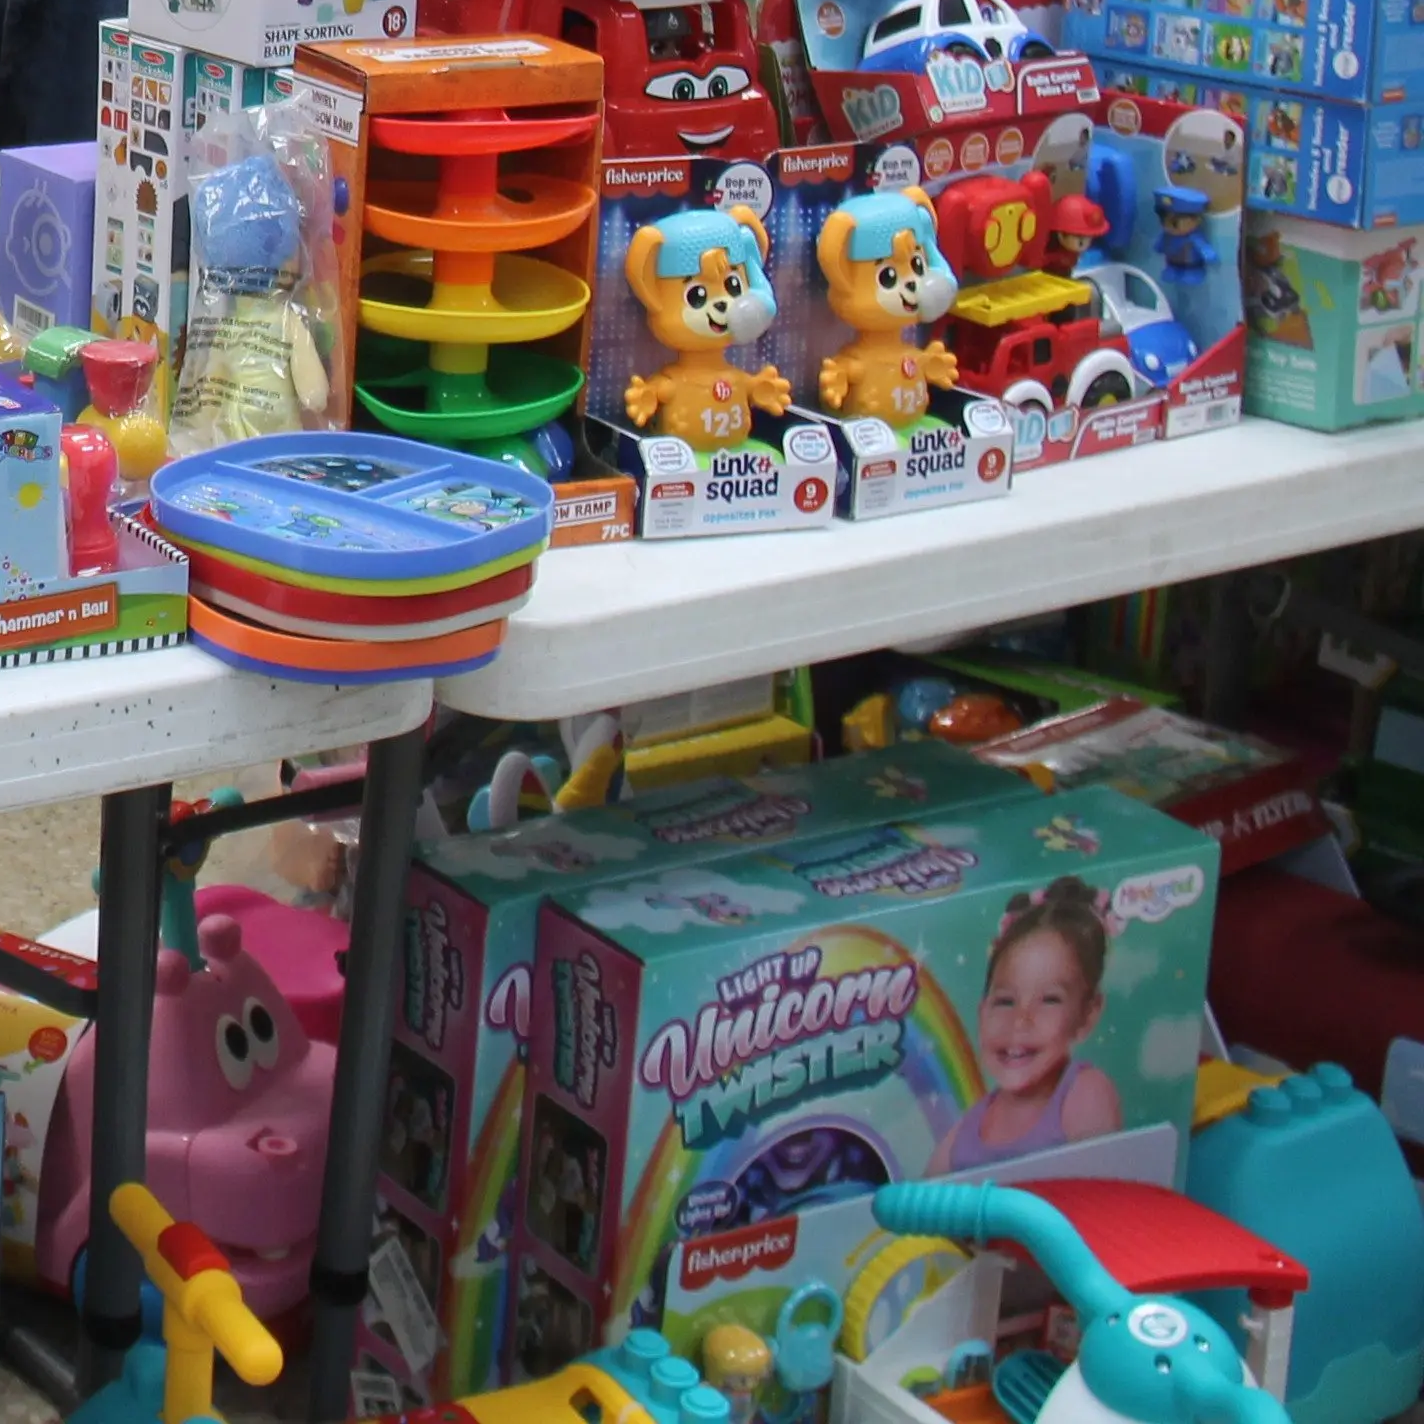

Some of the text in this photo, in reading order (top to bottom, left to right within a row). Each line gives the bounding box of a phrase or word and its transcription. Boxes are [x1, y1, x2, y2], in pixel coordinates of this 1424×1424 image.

[264, 24, 354, 45] SHAPE SORTING
[263, 45, 293, 59] BABY
[930, 60, 984, 100] KID
[844, 87, 900, 130] KID
[332, 113, 354, 134] RAMP
[782, 153, 849, 174] fisher-price
[605, 167, 684, 188] fisher-price
[725, 177, 764, 192] Bop my
[712, 452, 759, 477] Link
[906, 452, 965, 479] squad
[706, 475, 779, 504] squad
[574, 500, 613, 519] RAMP
[601, 524, 631, 540] 7PC
[68, 609, 77, 621] n
[81, 600, 110, 619] Ball
[719, 947, 822, 1003] LIGHT UP
[639, 964, 918, 1100] Unicorn
[674, 1021, 905, 1151] TWISTER
[688, 1233, 791, 1274] fisher-price
